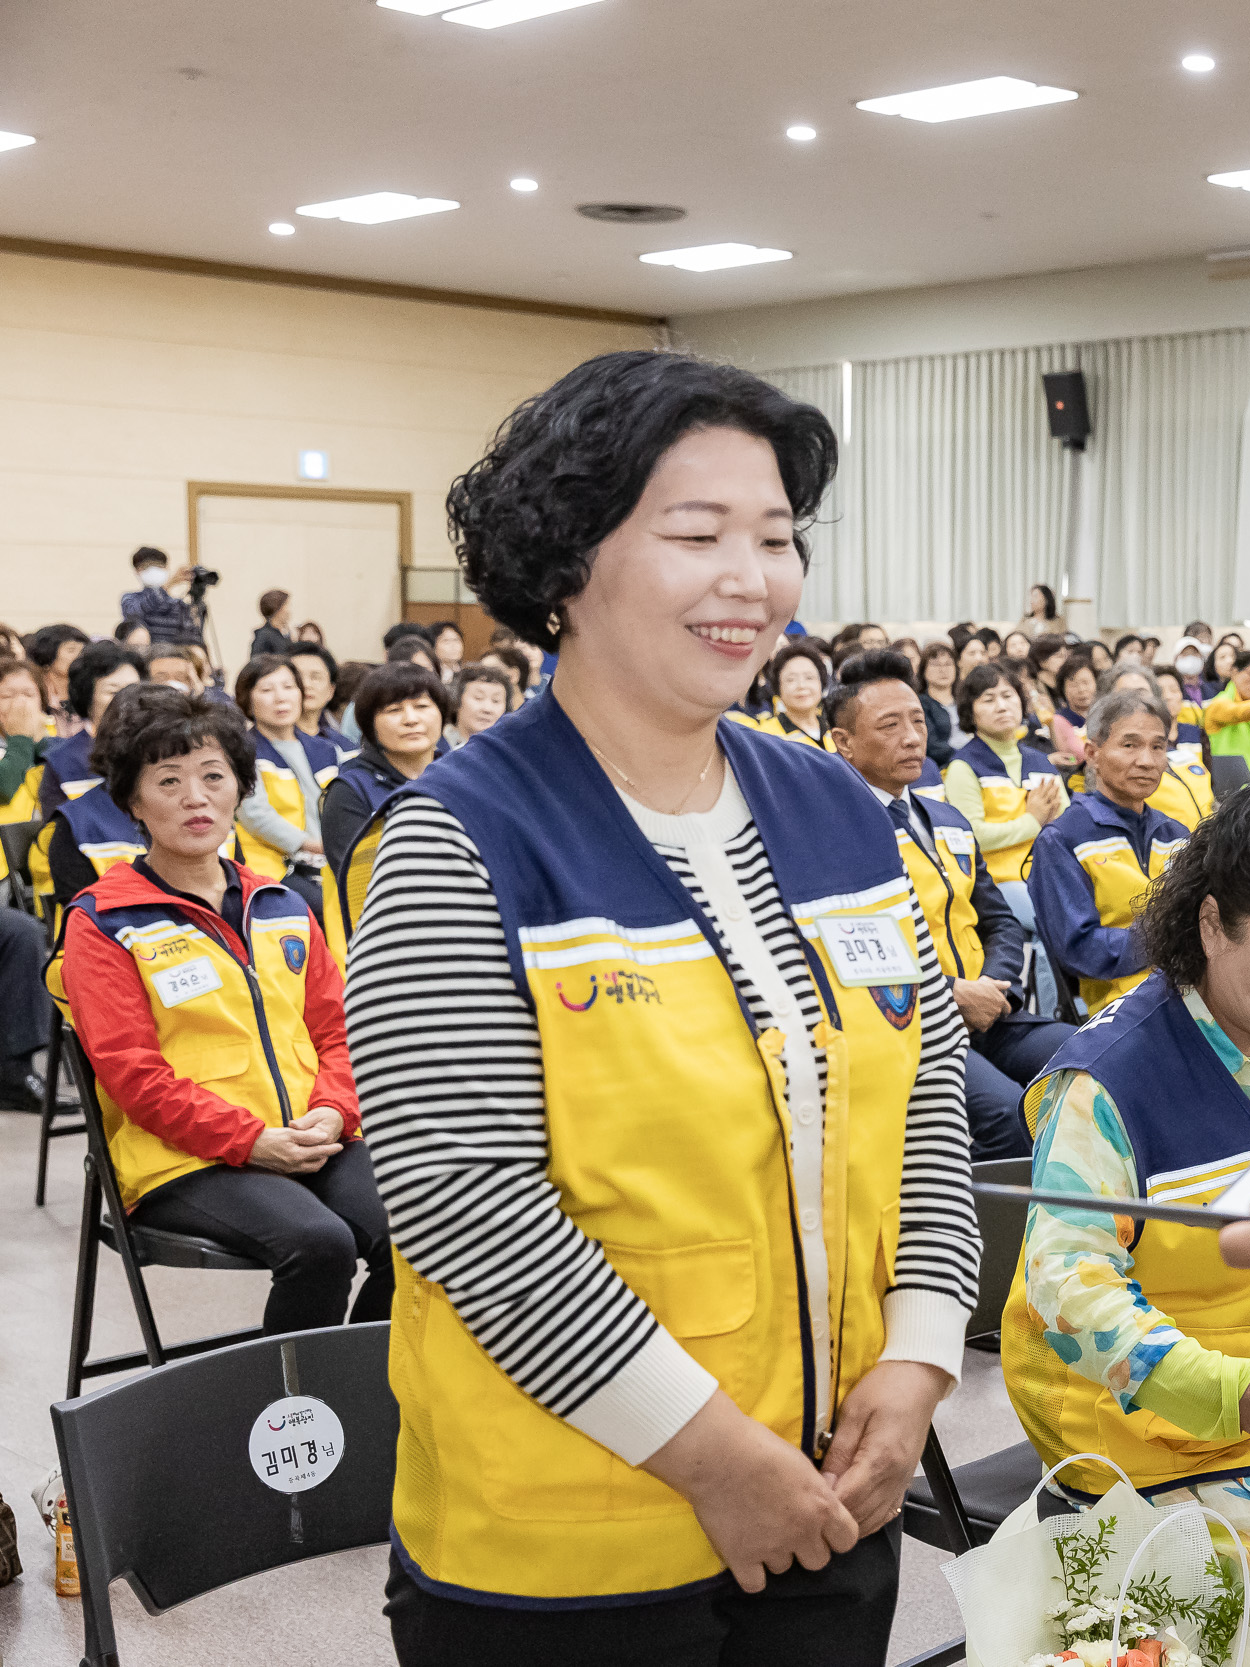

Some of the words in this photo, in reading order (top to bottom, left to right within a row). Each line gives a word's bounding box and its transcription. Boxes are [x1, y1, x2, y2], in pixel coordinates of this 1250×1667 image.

[838, 939, 887, 962] 김미경
[261, 1440, 318, 1477] 김미경
[321, 1441, 335, 1457] 님
